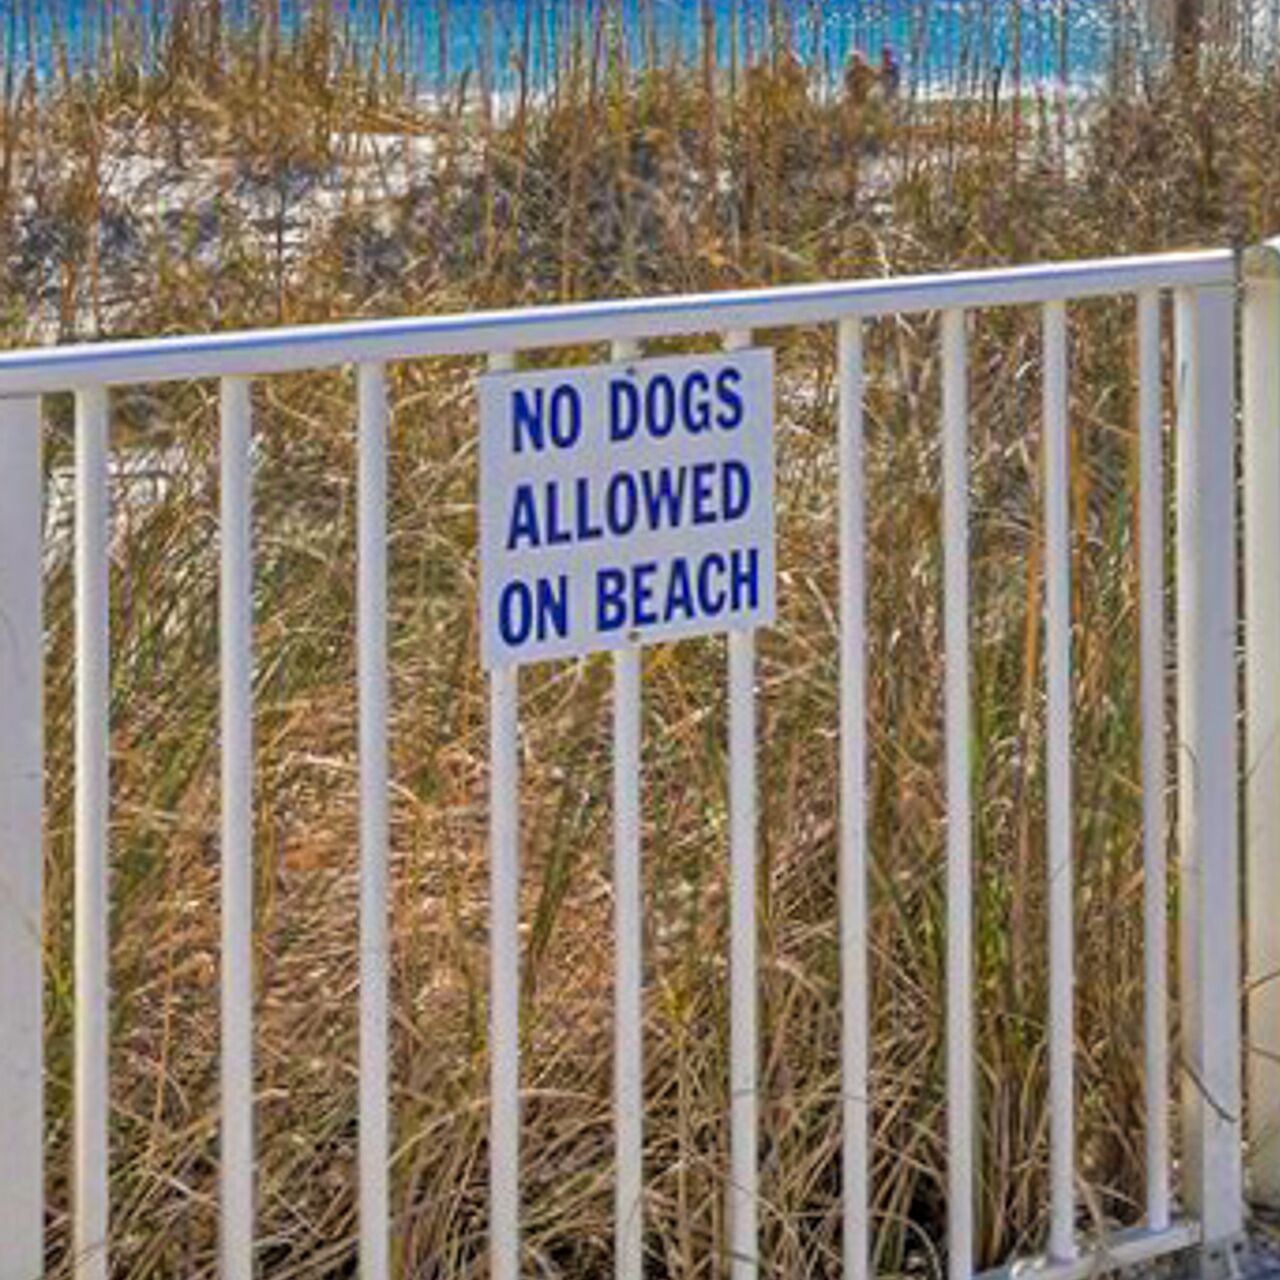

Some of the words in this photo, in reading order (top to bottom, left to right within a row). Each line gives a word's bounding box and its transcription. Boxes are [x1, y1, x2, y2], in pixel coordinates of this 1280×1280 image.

[511, 384, 582, 453] NO
[608, 367, 744, 442] DOGS
[507, 459, 751, 550] ALLOWED
[499, 575, 568, 646] ON
[596, 548, 758, 632] BEACH
